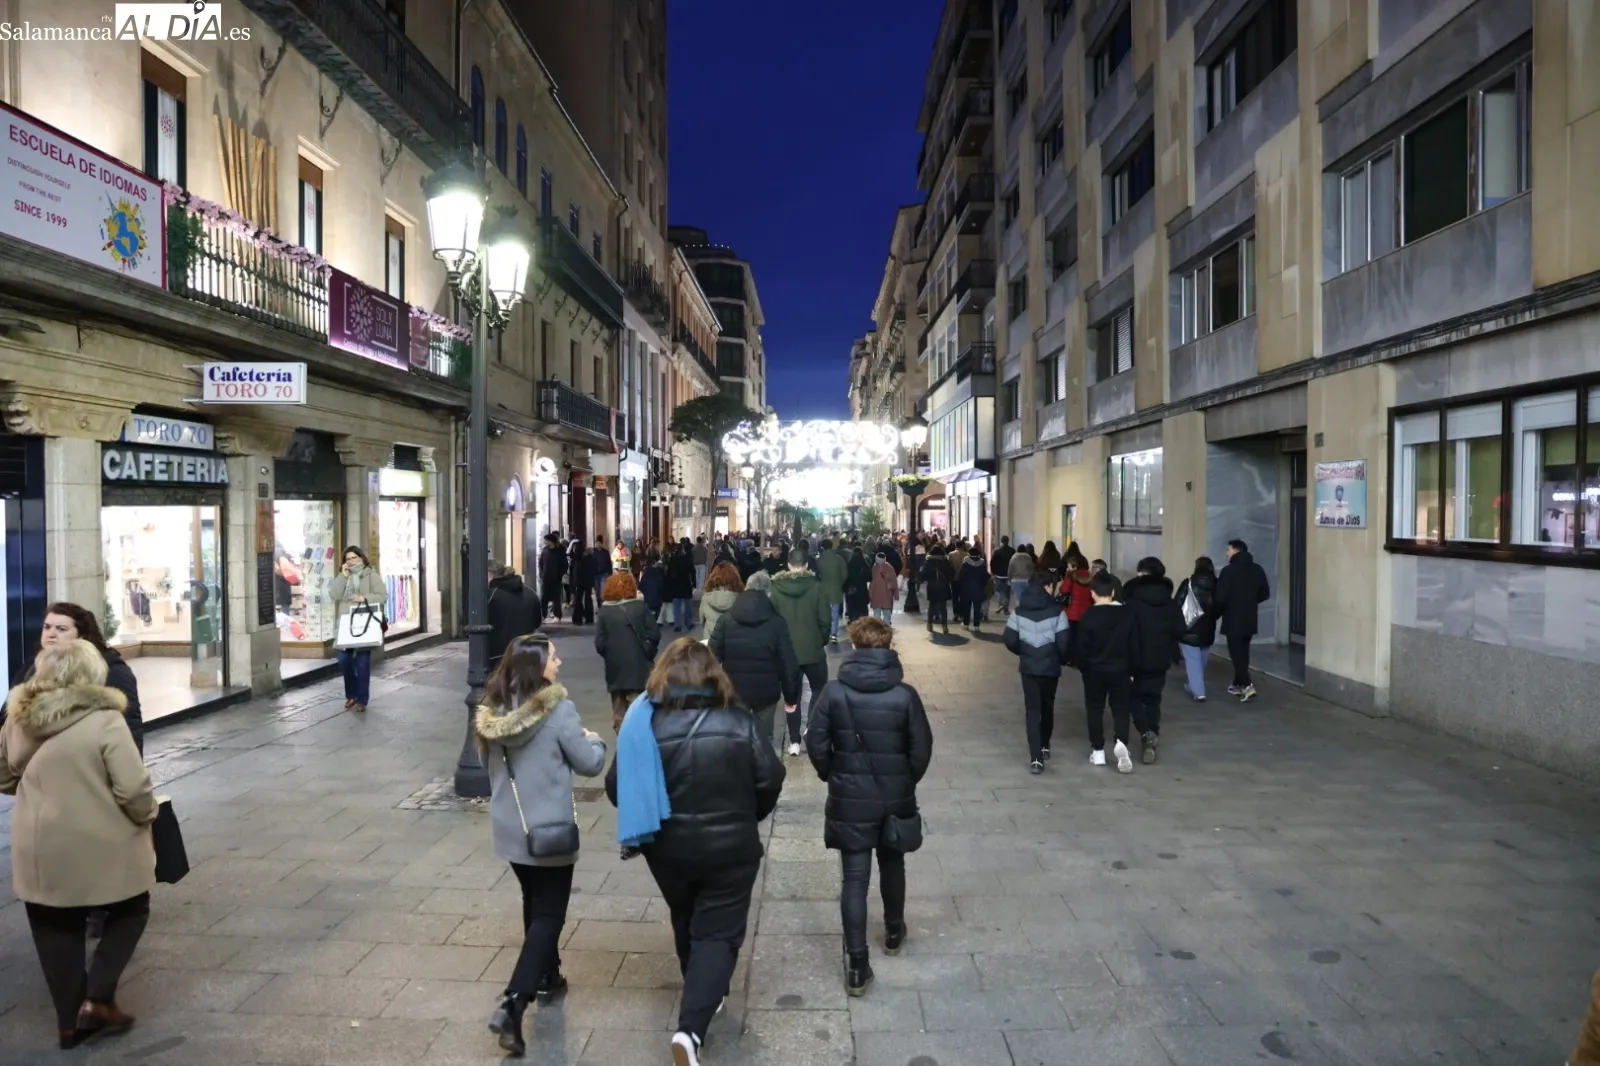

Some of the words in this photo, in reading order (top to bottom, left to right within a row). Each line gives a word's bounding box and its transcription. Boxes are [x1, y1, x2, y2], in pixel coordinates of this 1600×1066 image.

[9, 124, 76, 169] ESCUELA
[79, 157, 97, 178] DE
[99, 167, 148, 202] IDIOMAS
[19, 180, 36, 193] FROM
[14, 199, 42, 219] SINCE
[46, 211, 68, 228] 1999
[375, 321, 393, 342] LUNA
[208, 365, 292, 382] Cafetería
[211, 383, 267, 398] TORO
[274, 385, 293, 398] 70
[134, 418, 182, 442] TORO
[188, 425, 207, 445] 70
[103, 449, 229, 483] CAFETERIA
